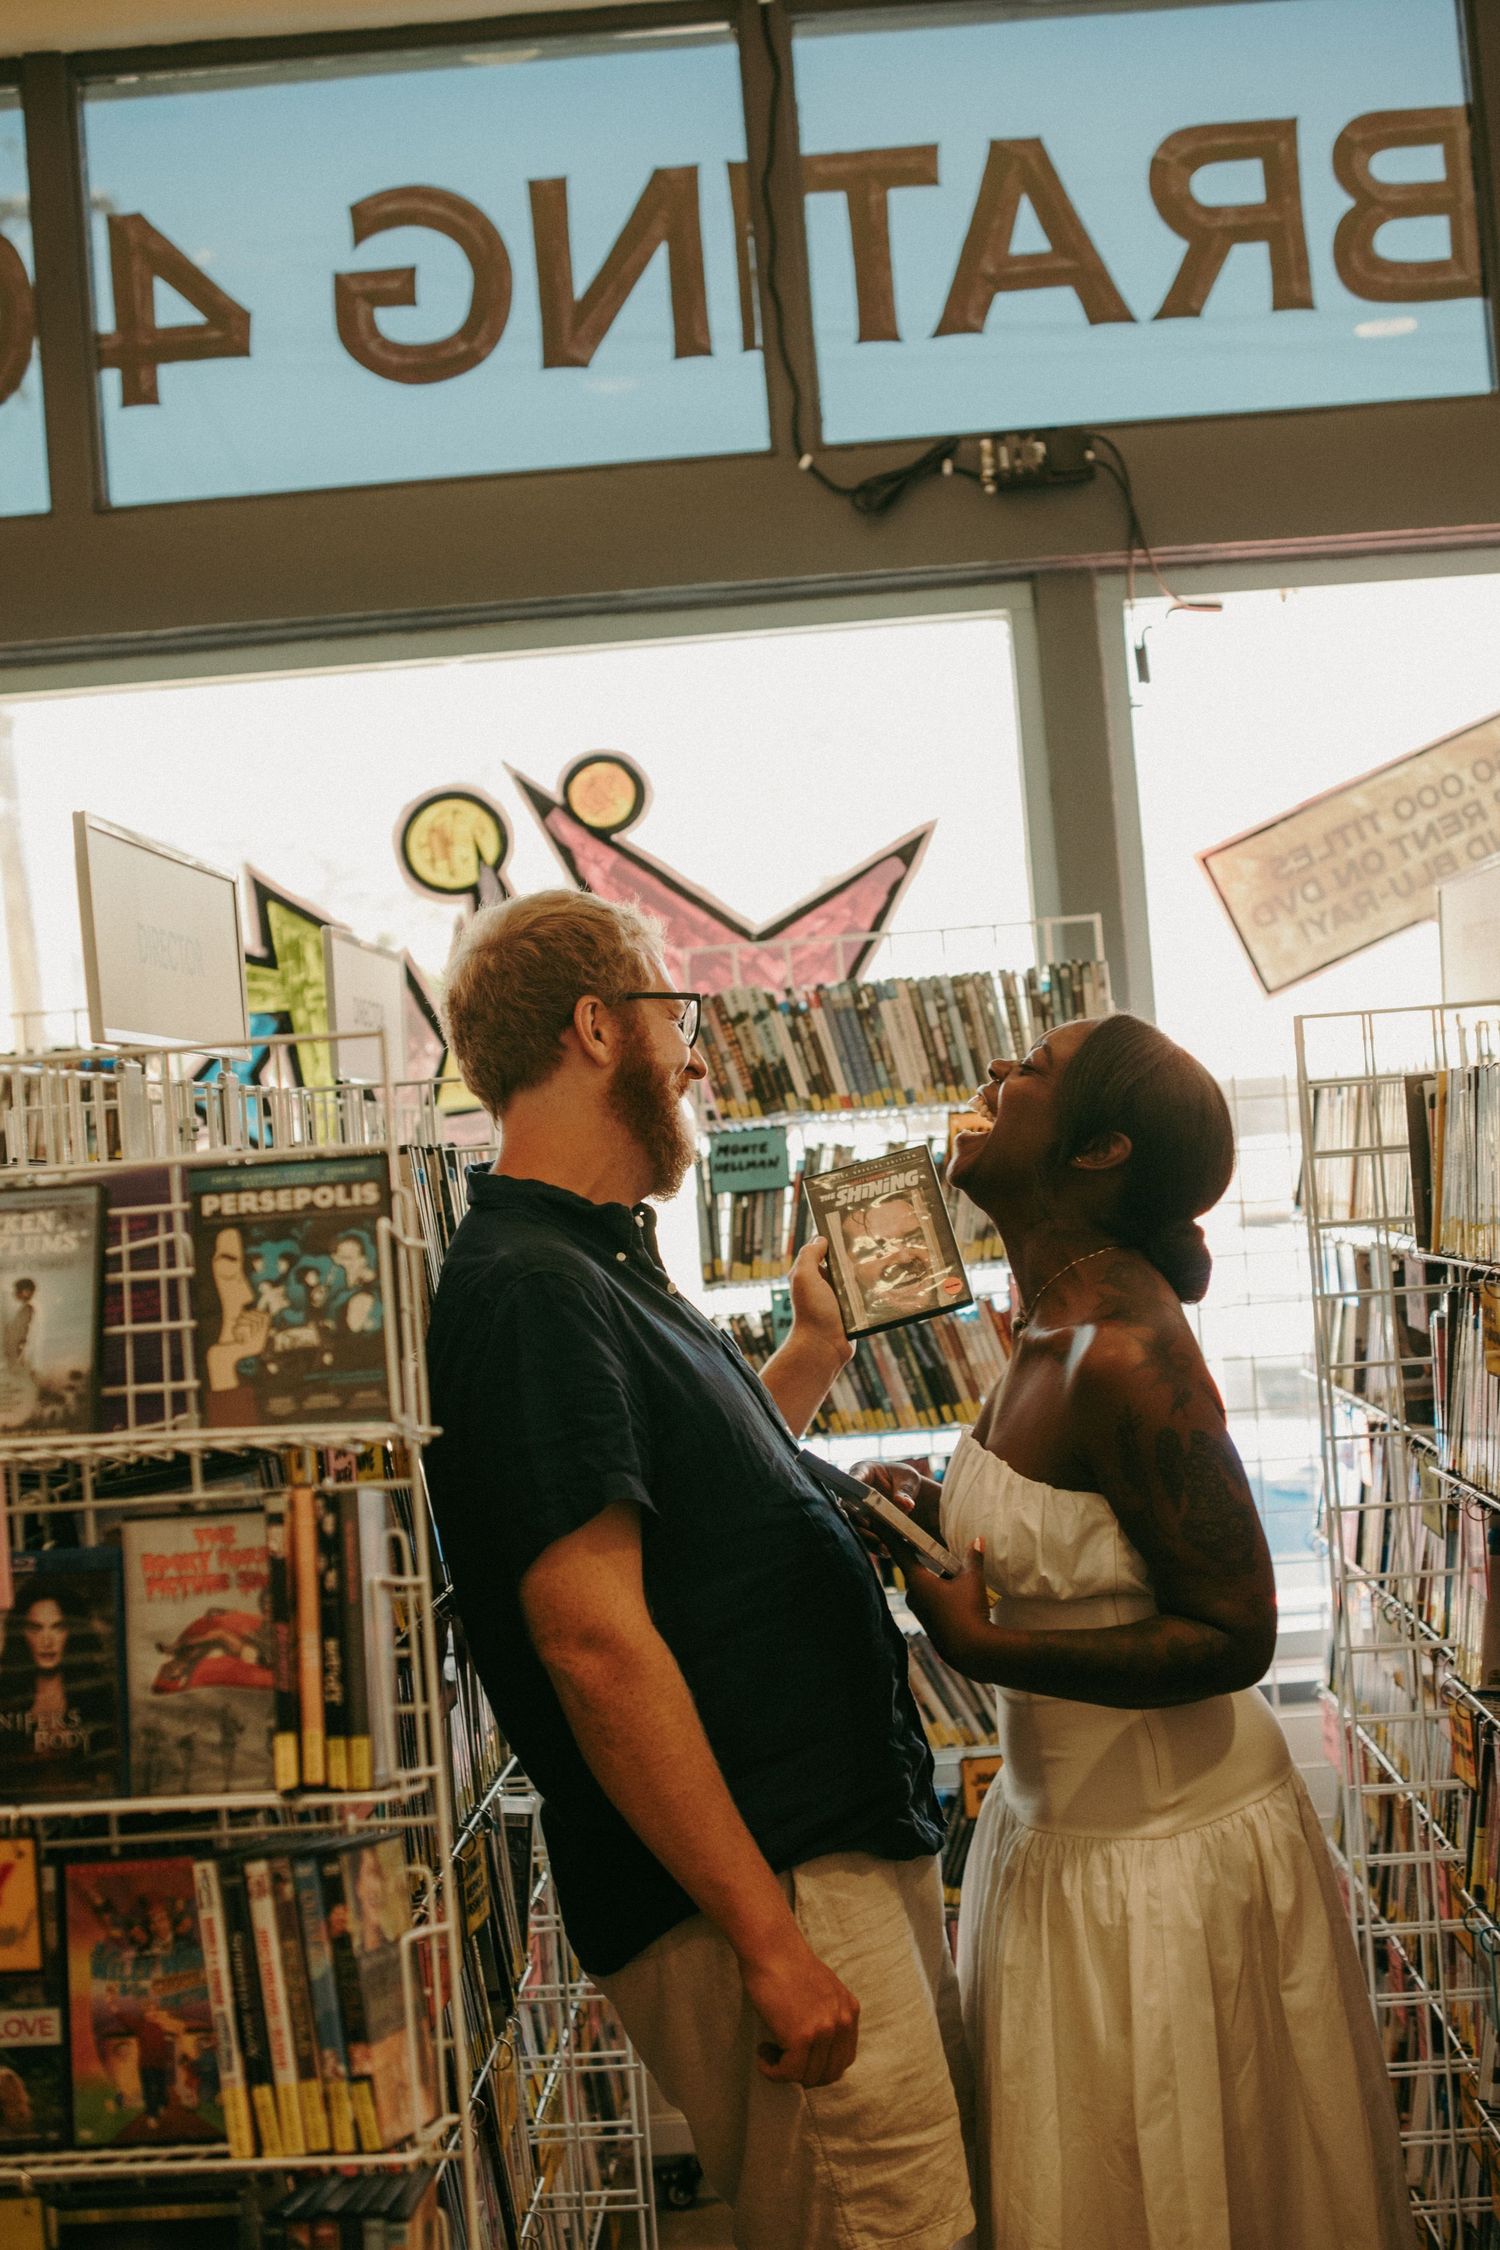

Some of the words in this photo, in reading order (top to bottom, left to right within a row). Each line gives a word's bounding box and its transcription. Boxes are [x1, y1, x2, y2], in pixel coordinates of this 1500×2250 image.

[717, 1141, 769, 1157] MONTE
[713, 1156, 781, 1174] HELLMAN
[201, 1181, 381, 1217] PERSEPOLIS
[0, 2014, 55, 2039] OVE
